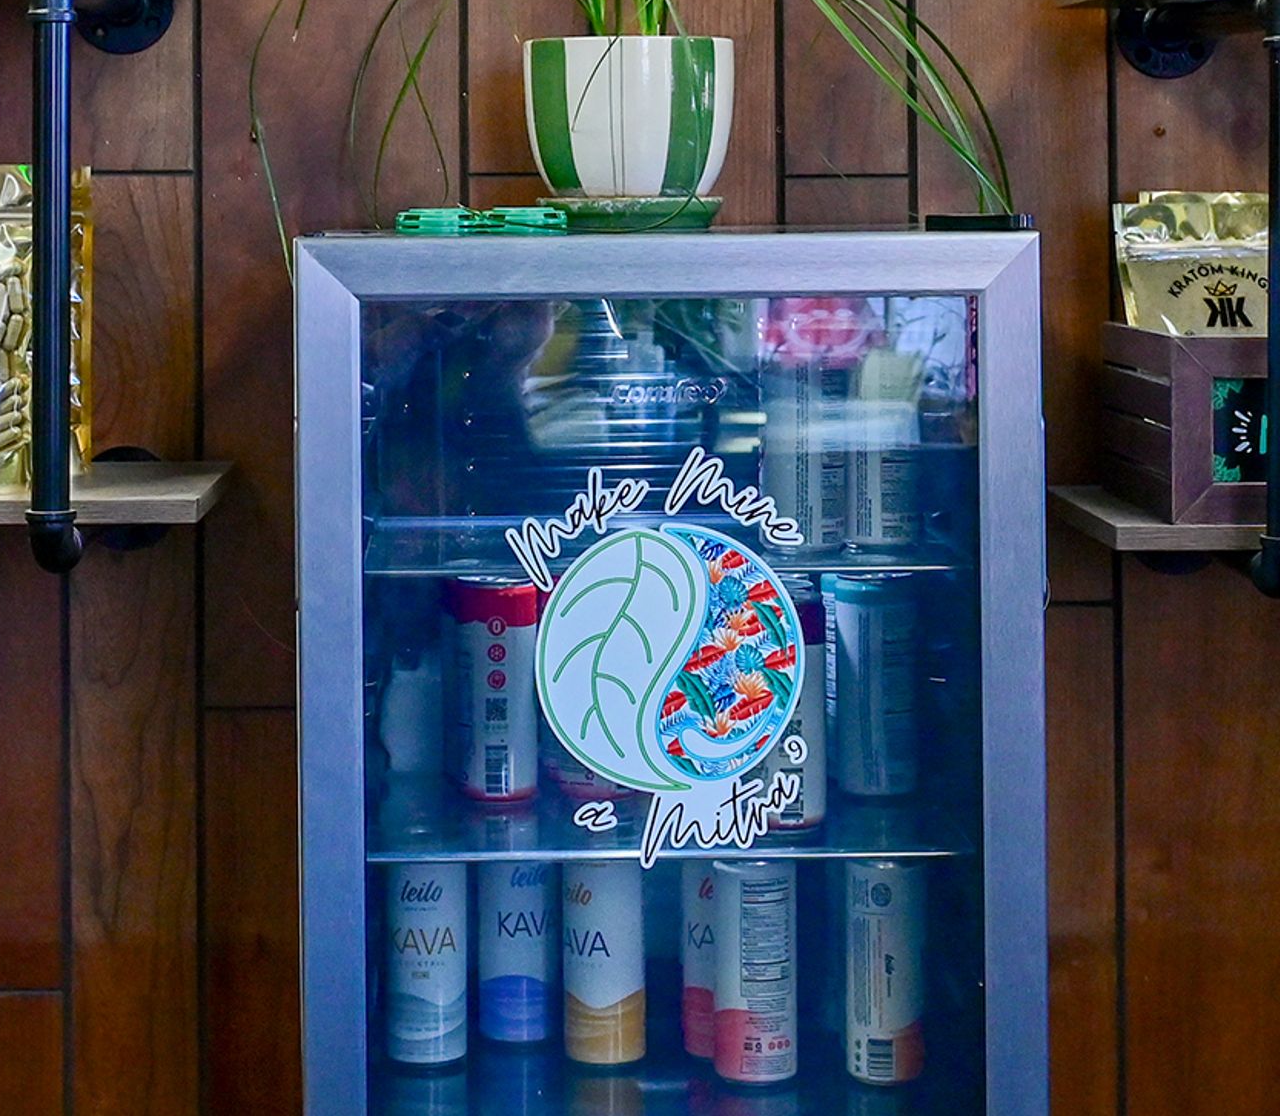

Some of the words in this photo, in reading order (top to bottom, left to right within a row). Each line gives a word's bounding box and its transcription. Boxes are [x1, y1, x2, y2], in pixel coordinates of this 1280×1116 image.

[1167, 264, 1224, 299] KRATOM
[1229, 265, 1271, 294] KING
[508, 468, 645, 585] Make
[669, 451, 800, 543] Mine
[644, 772, 797, 865] Mitra
[400, 879, 444, 903] leilo
[497, 910, 548, 939] KAV
